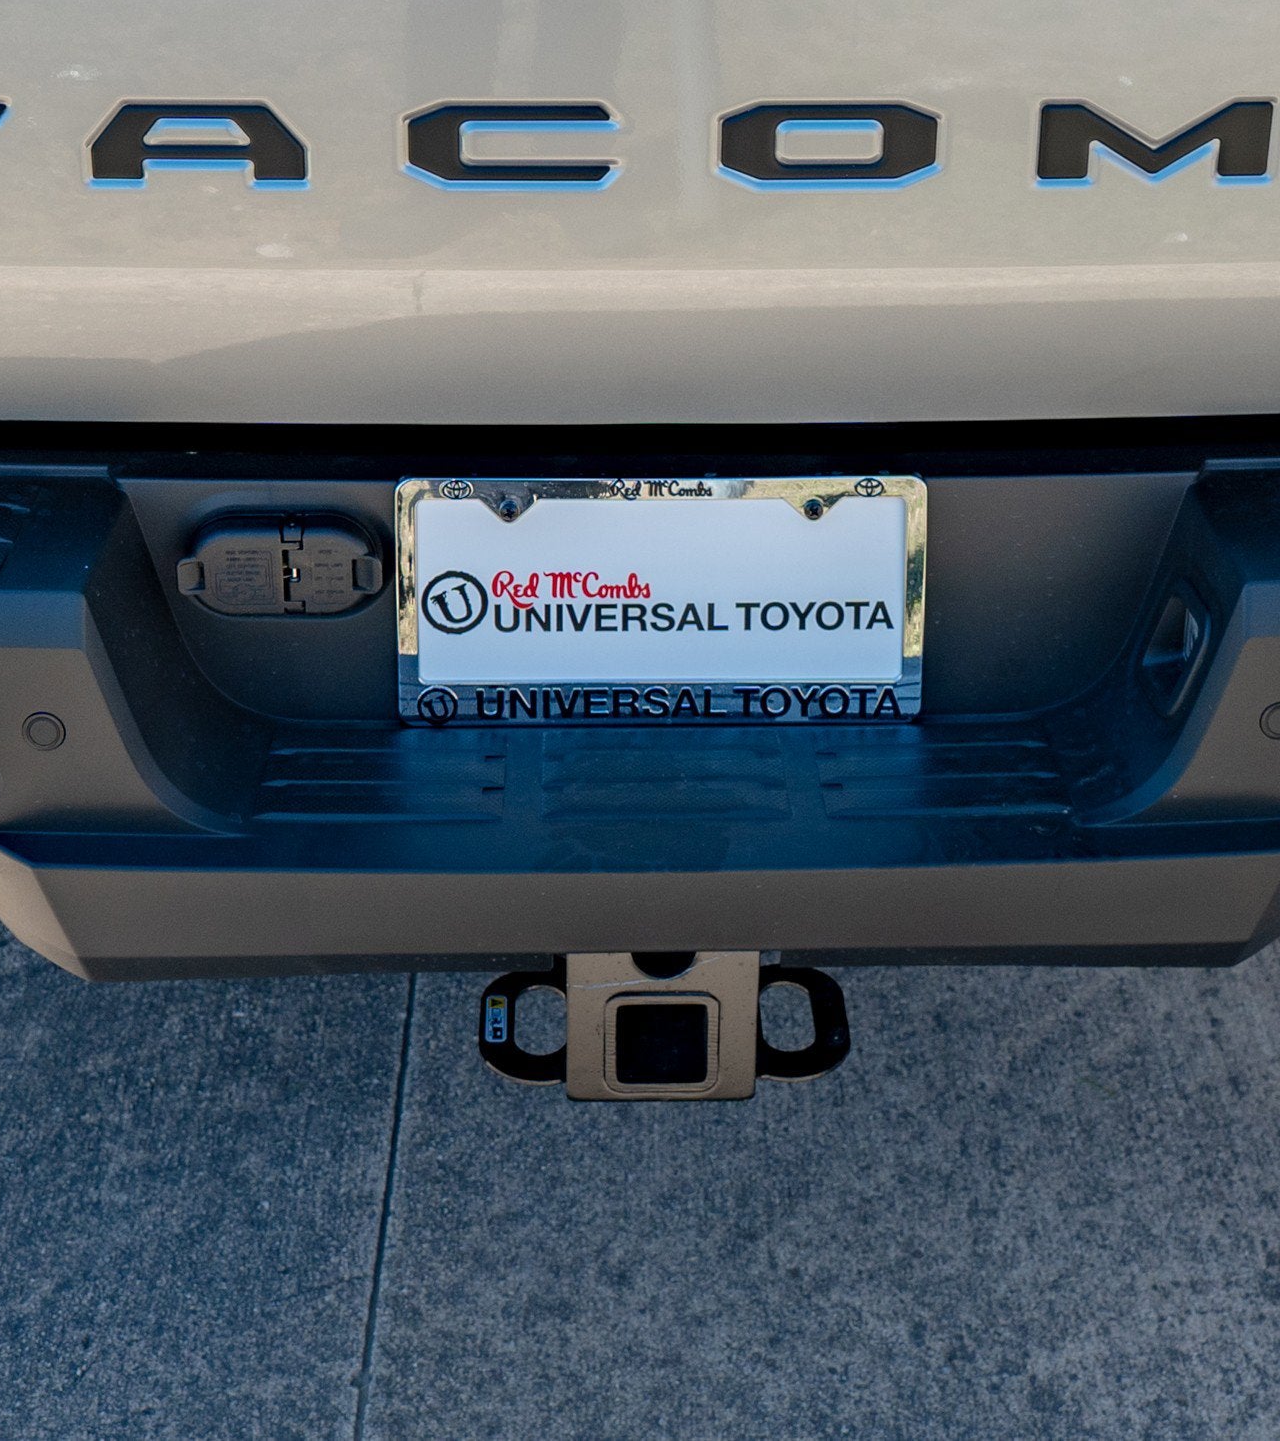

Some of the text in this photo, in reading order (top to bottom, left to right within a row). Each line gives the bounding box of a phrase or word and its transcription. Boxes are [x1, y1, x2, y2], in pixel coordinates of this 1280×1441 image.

[609, 478, 713, 500] Red McCombs
[492, 571, 651, 609] Red McCombs
[494, 601, 894, 633] UNIVERSAL TOYOTA
[476, 686, 902, 719] UNIVERSAL TOYOTA
